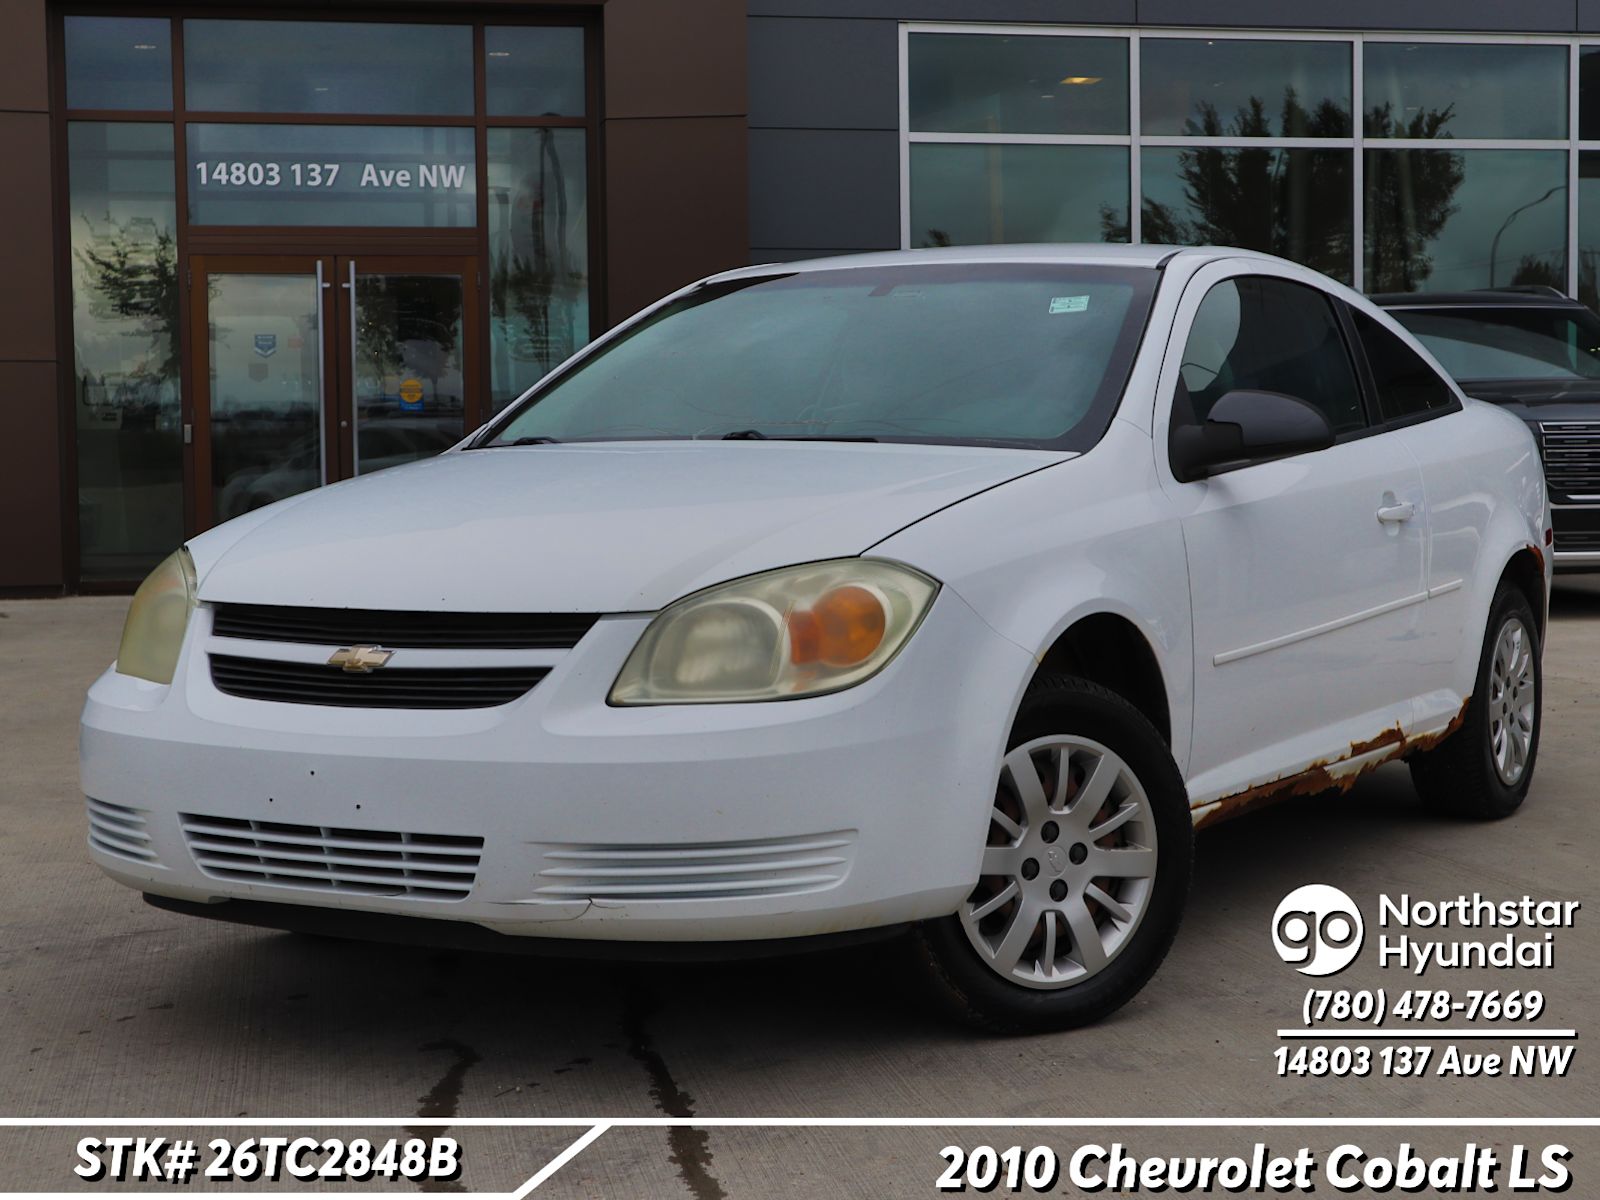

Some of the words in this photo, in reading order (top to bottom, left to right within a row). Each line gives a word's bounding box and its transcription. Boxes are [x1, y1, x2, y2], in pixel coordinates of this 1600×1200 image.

[196, 162, 282, 187] 14803
[290, 163, 340, 187] 137
[360, 163, 411, 188] Ave
[418, 164, 466, 189] NW
